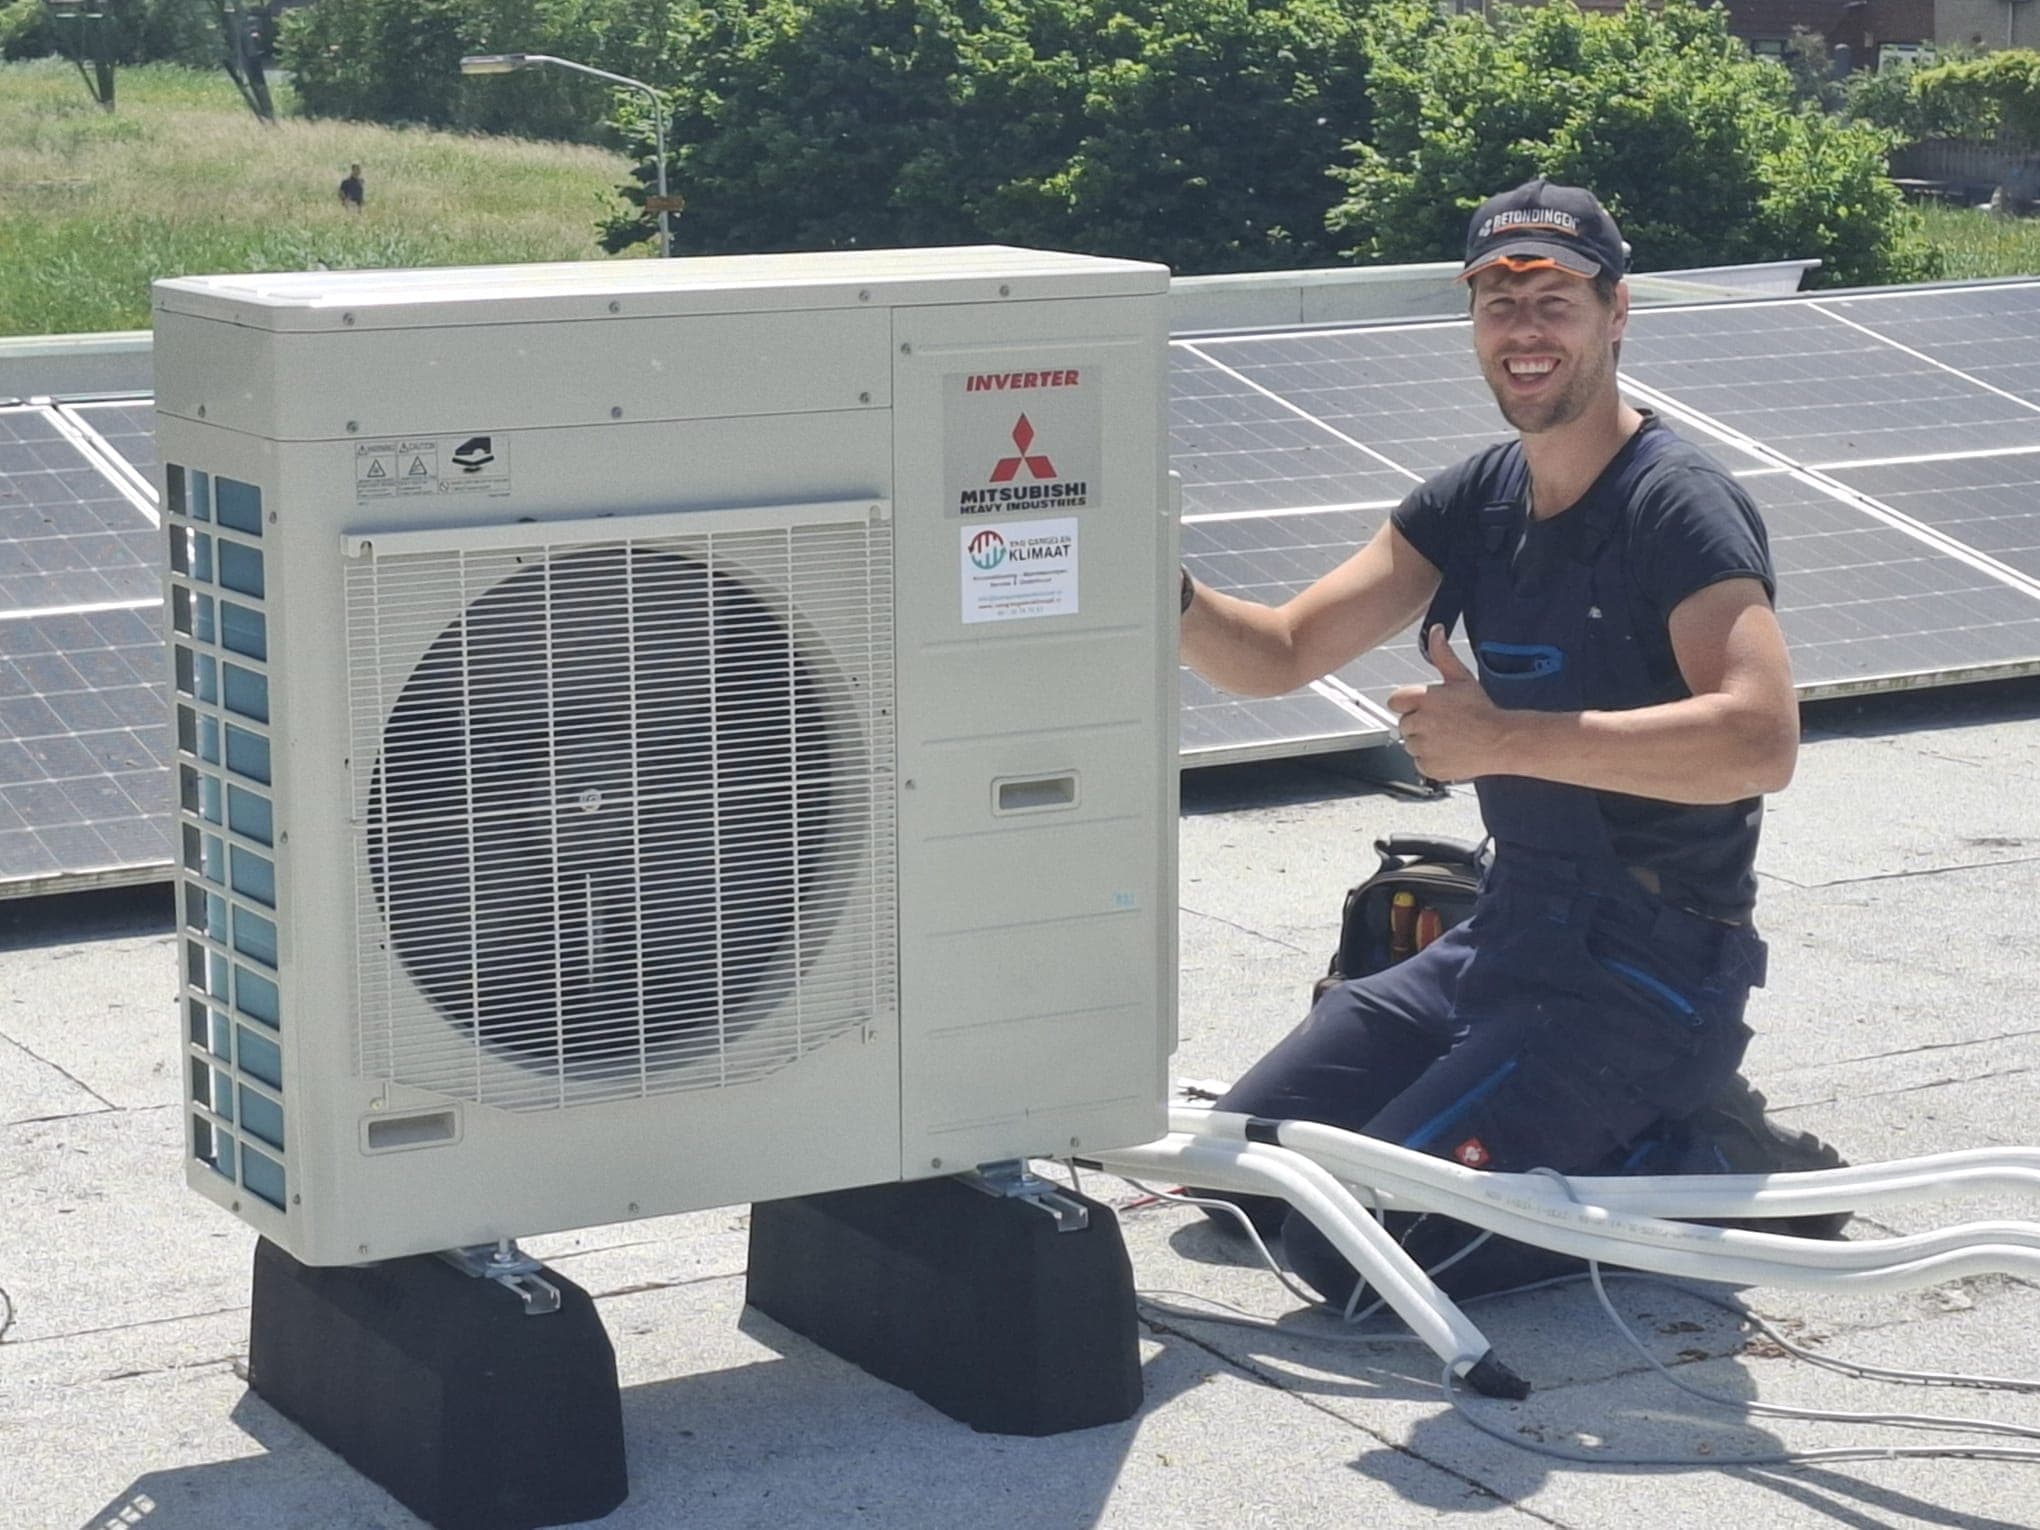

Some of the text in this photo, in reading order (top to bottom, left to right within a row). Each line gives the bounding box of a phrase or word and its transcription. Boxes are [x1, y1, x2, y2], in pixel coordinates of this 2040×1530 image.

[966, 370, 1080, 392] INVERTER
[960, 482, 1087, 504] MITSUBISHI
[960, 497, 1086, 515] HEAVY INDUSTRIES
[1009, 544, 1071, 561] KLIMAAT
